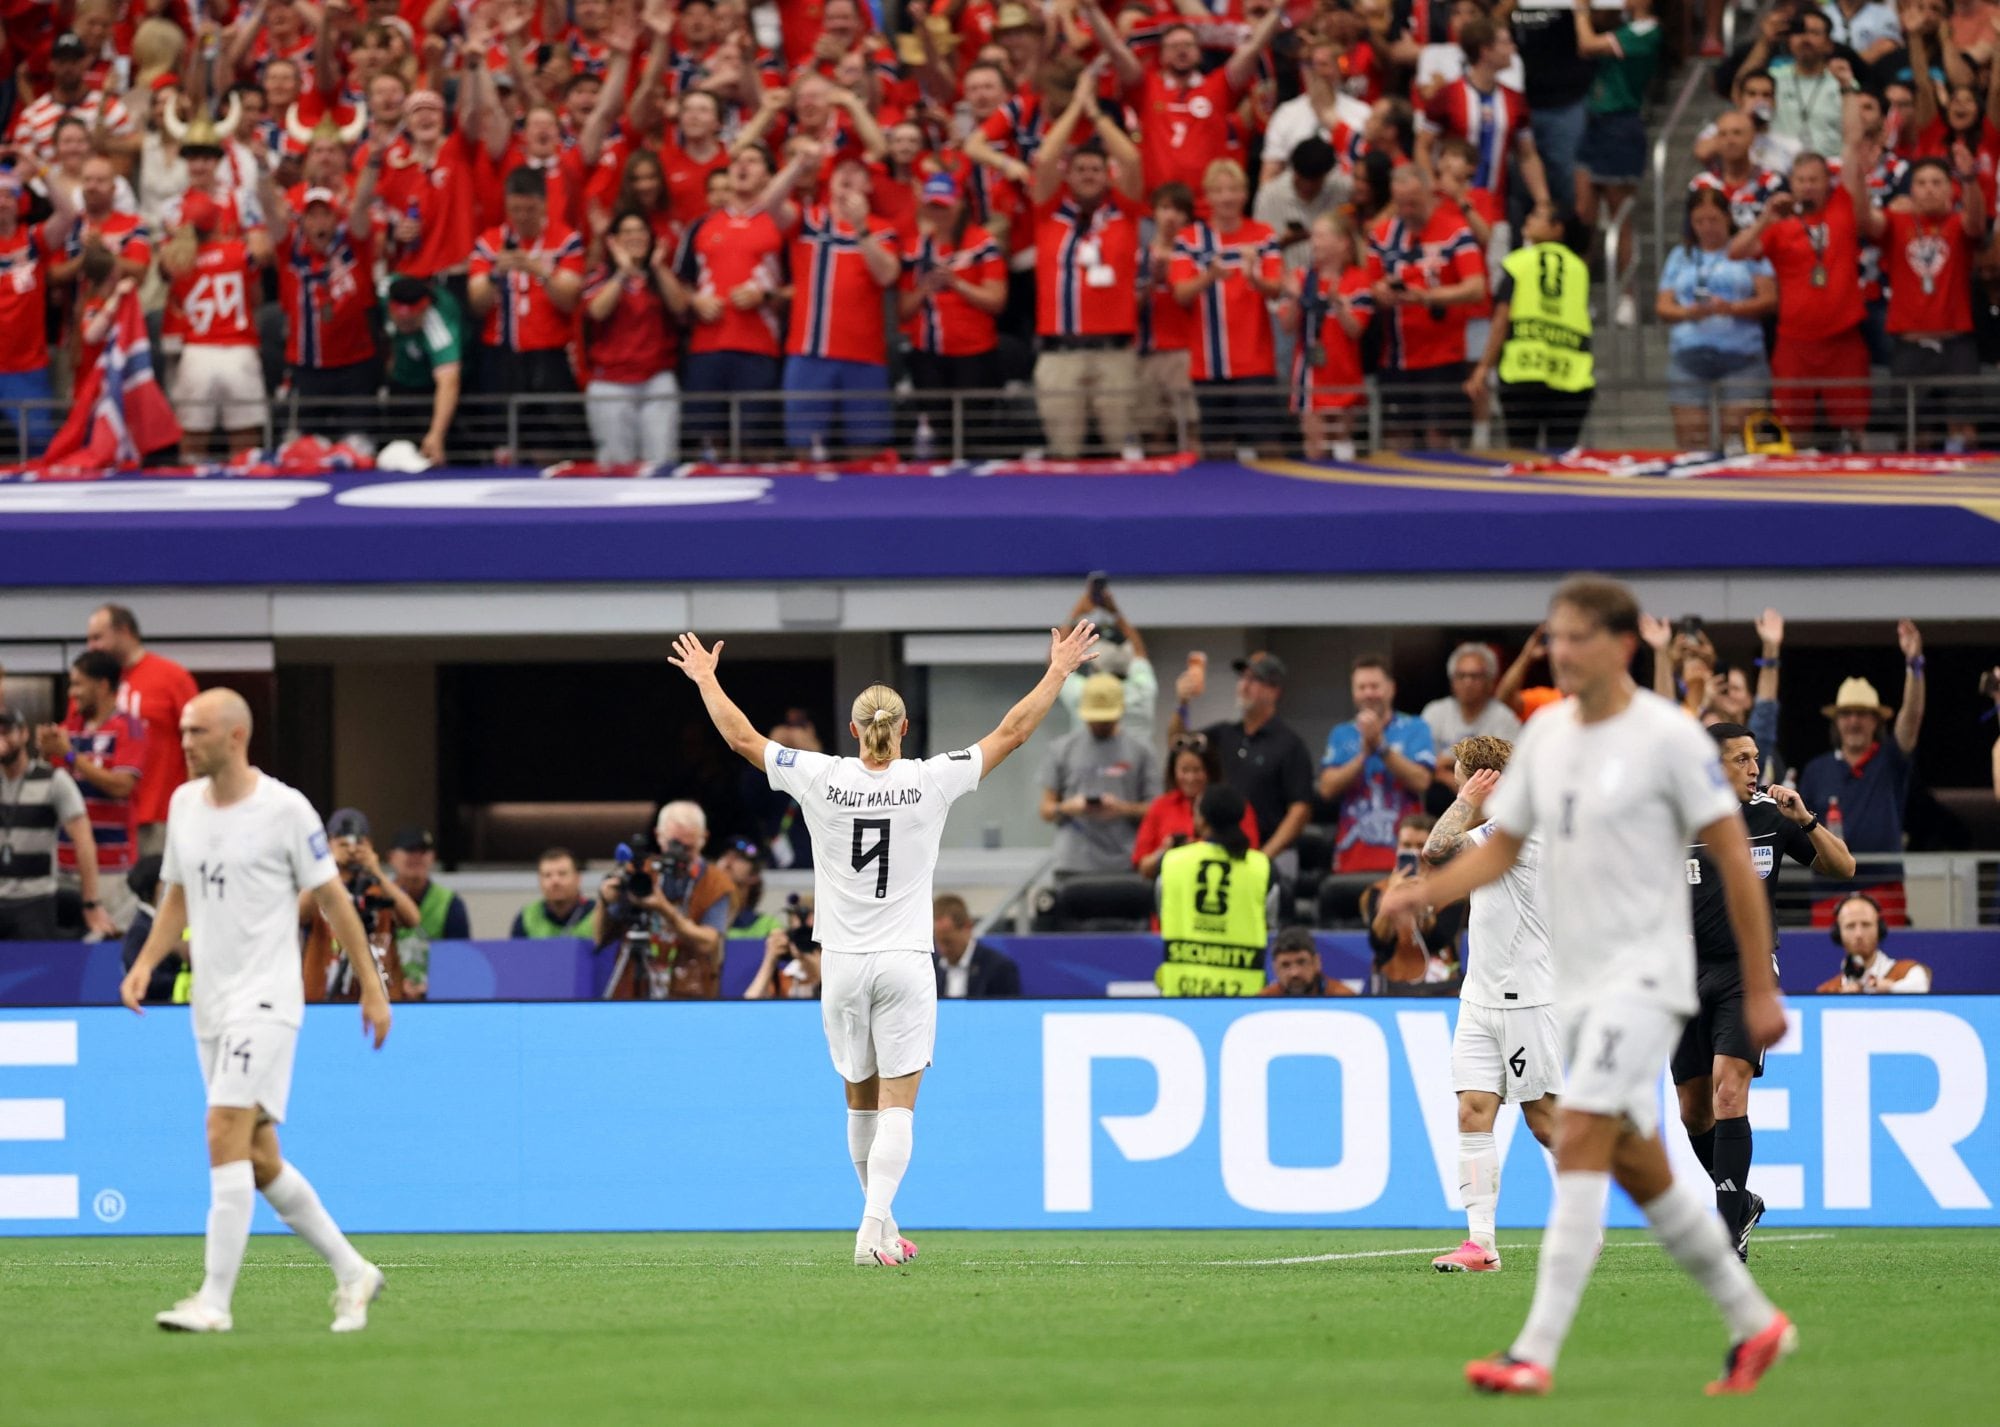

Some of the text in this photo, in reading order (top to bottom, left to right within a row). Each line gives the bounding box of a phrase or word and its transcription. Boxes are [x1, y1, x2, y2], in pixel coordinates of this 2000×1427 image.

[826, 784, 922, 808] BRAUT HAALAND
[851, 818, 891, 898] 9
[1753, 848, 1772, 857] FIFA
[199, 861, 225, 899] 14
[1168, 941, 1257, 968] SECURITY
[1509, 1046, 1526, 1078] 6
